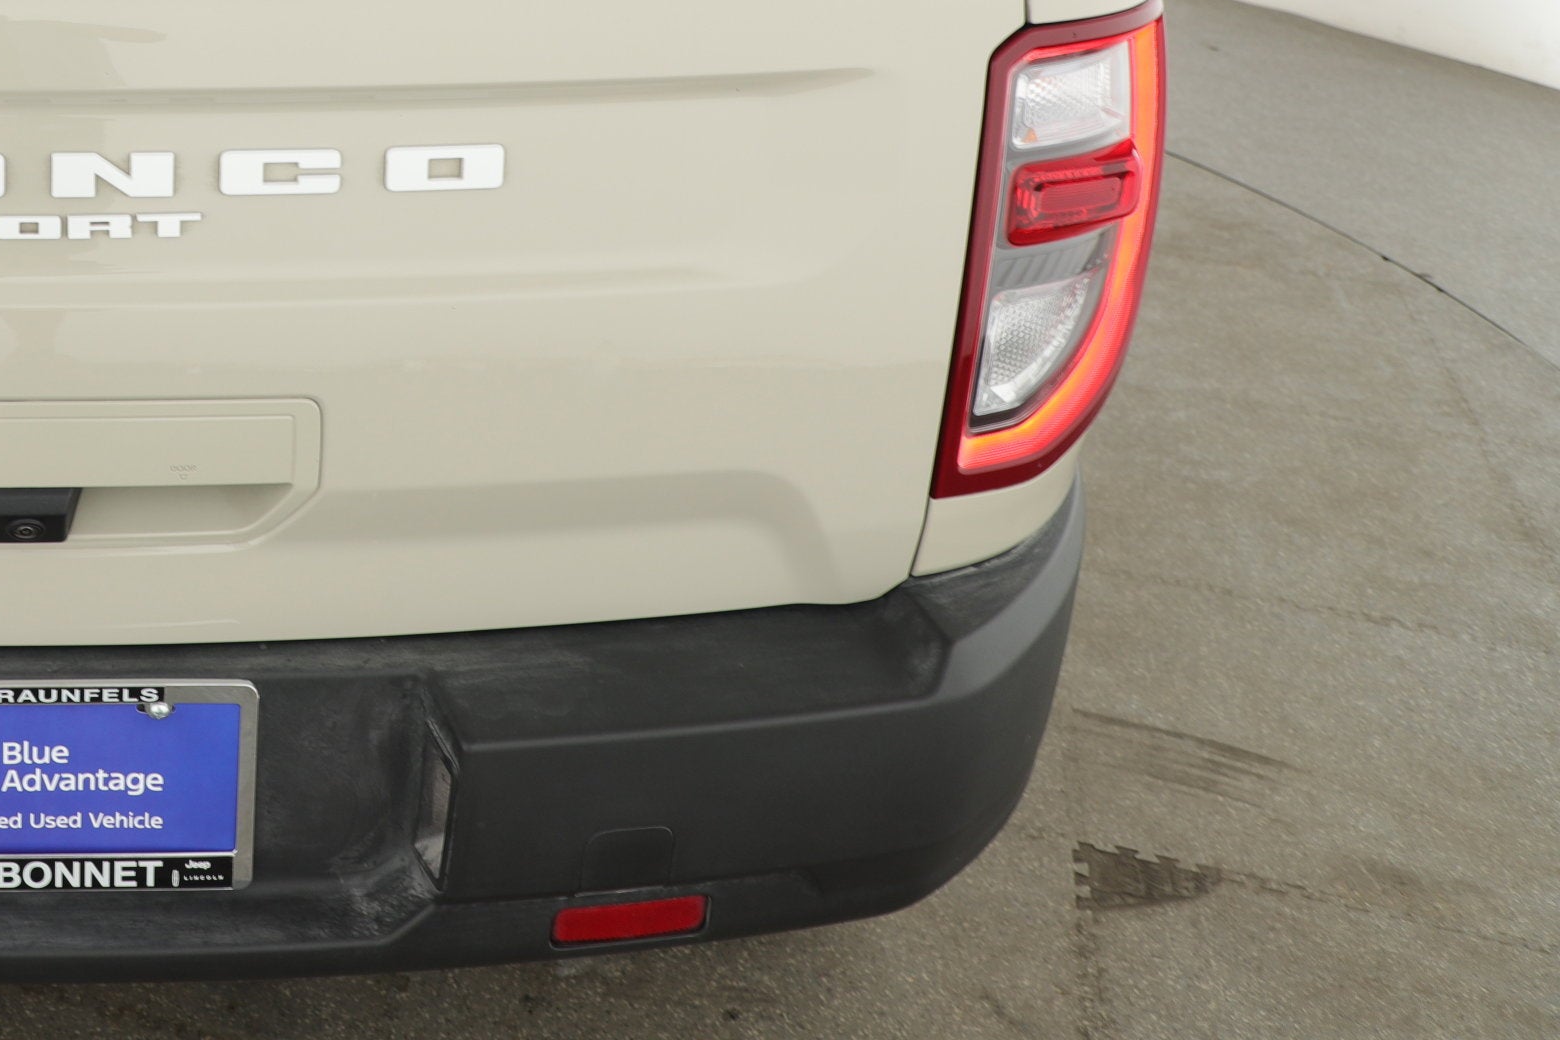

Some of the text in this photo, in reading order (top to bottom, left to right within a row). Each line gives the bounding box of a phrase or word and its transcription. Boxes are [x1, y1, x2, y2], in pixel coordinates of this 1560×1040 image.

[2, 740, 70, 765] Blue
[1, 768, 164, 796] Advantage
[29, 812, 82, 829] Used
[89, 812, 164, 829] Vehicle
